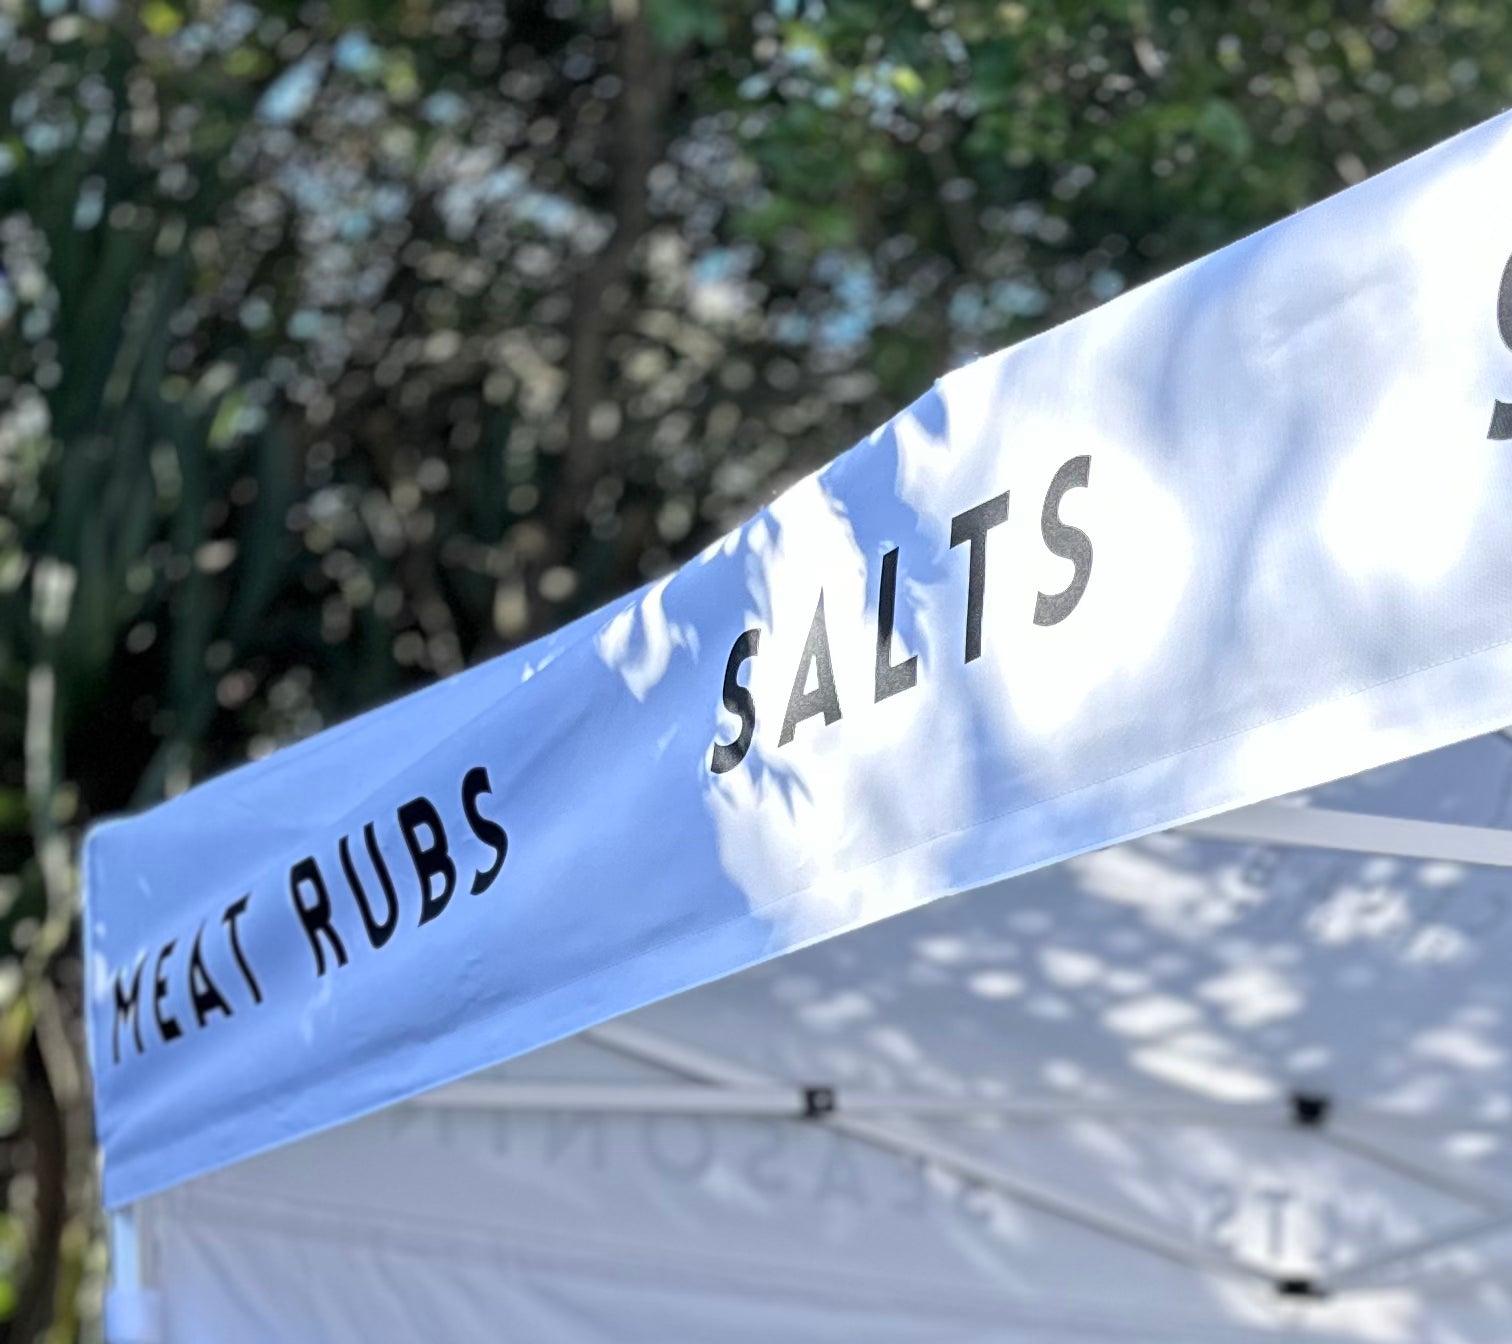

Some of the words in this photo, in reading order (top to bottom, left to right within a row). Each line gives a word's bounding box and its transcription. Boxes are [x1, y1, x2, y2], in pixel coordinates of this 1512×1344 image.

[112, 891, 264, 1064] MEAT
[289, 766, 509, 977] RUBS
[710, 454, 1093, 774] SALTS
